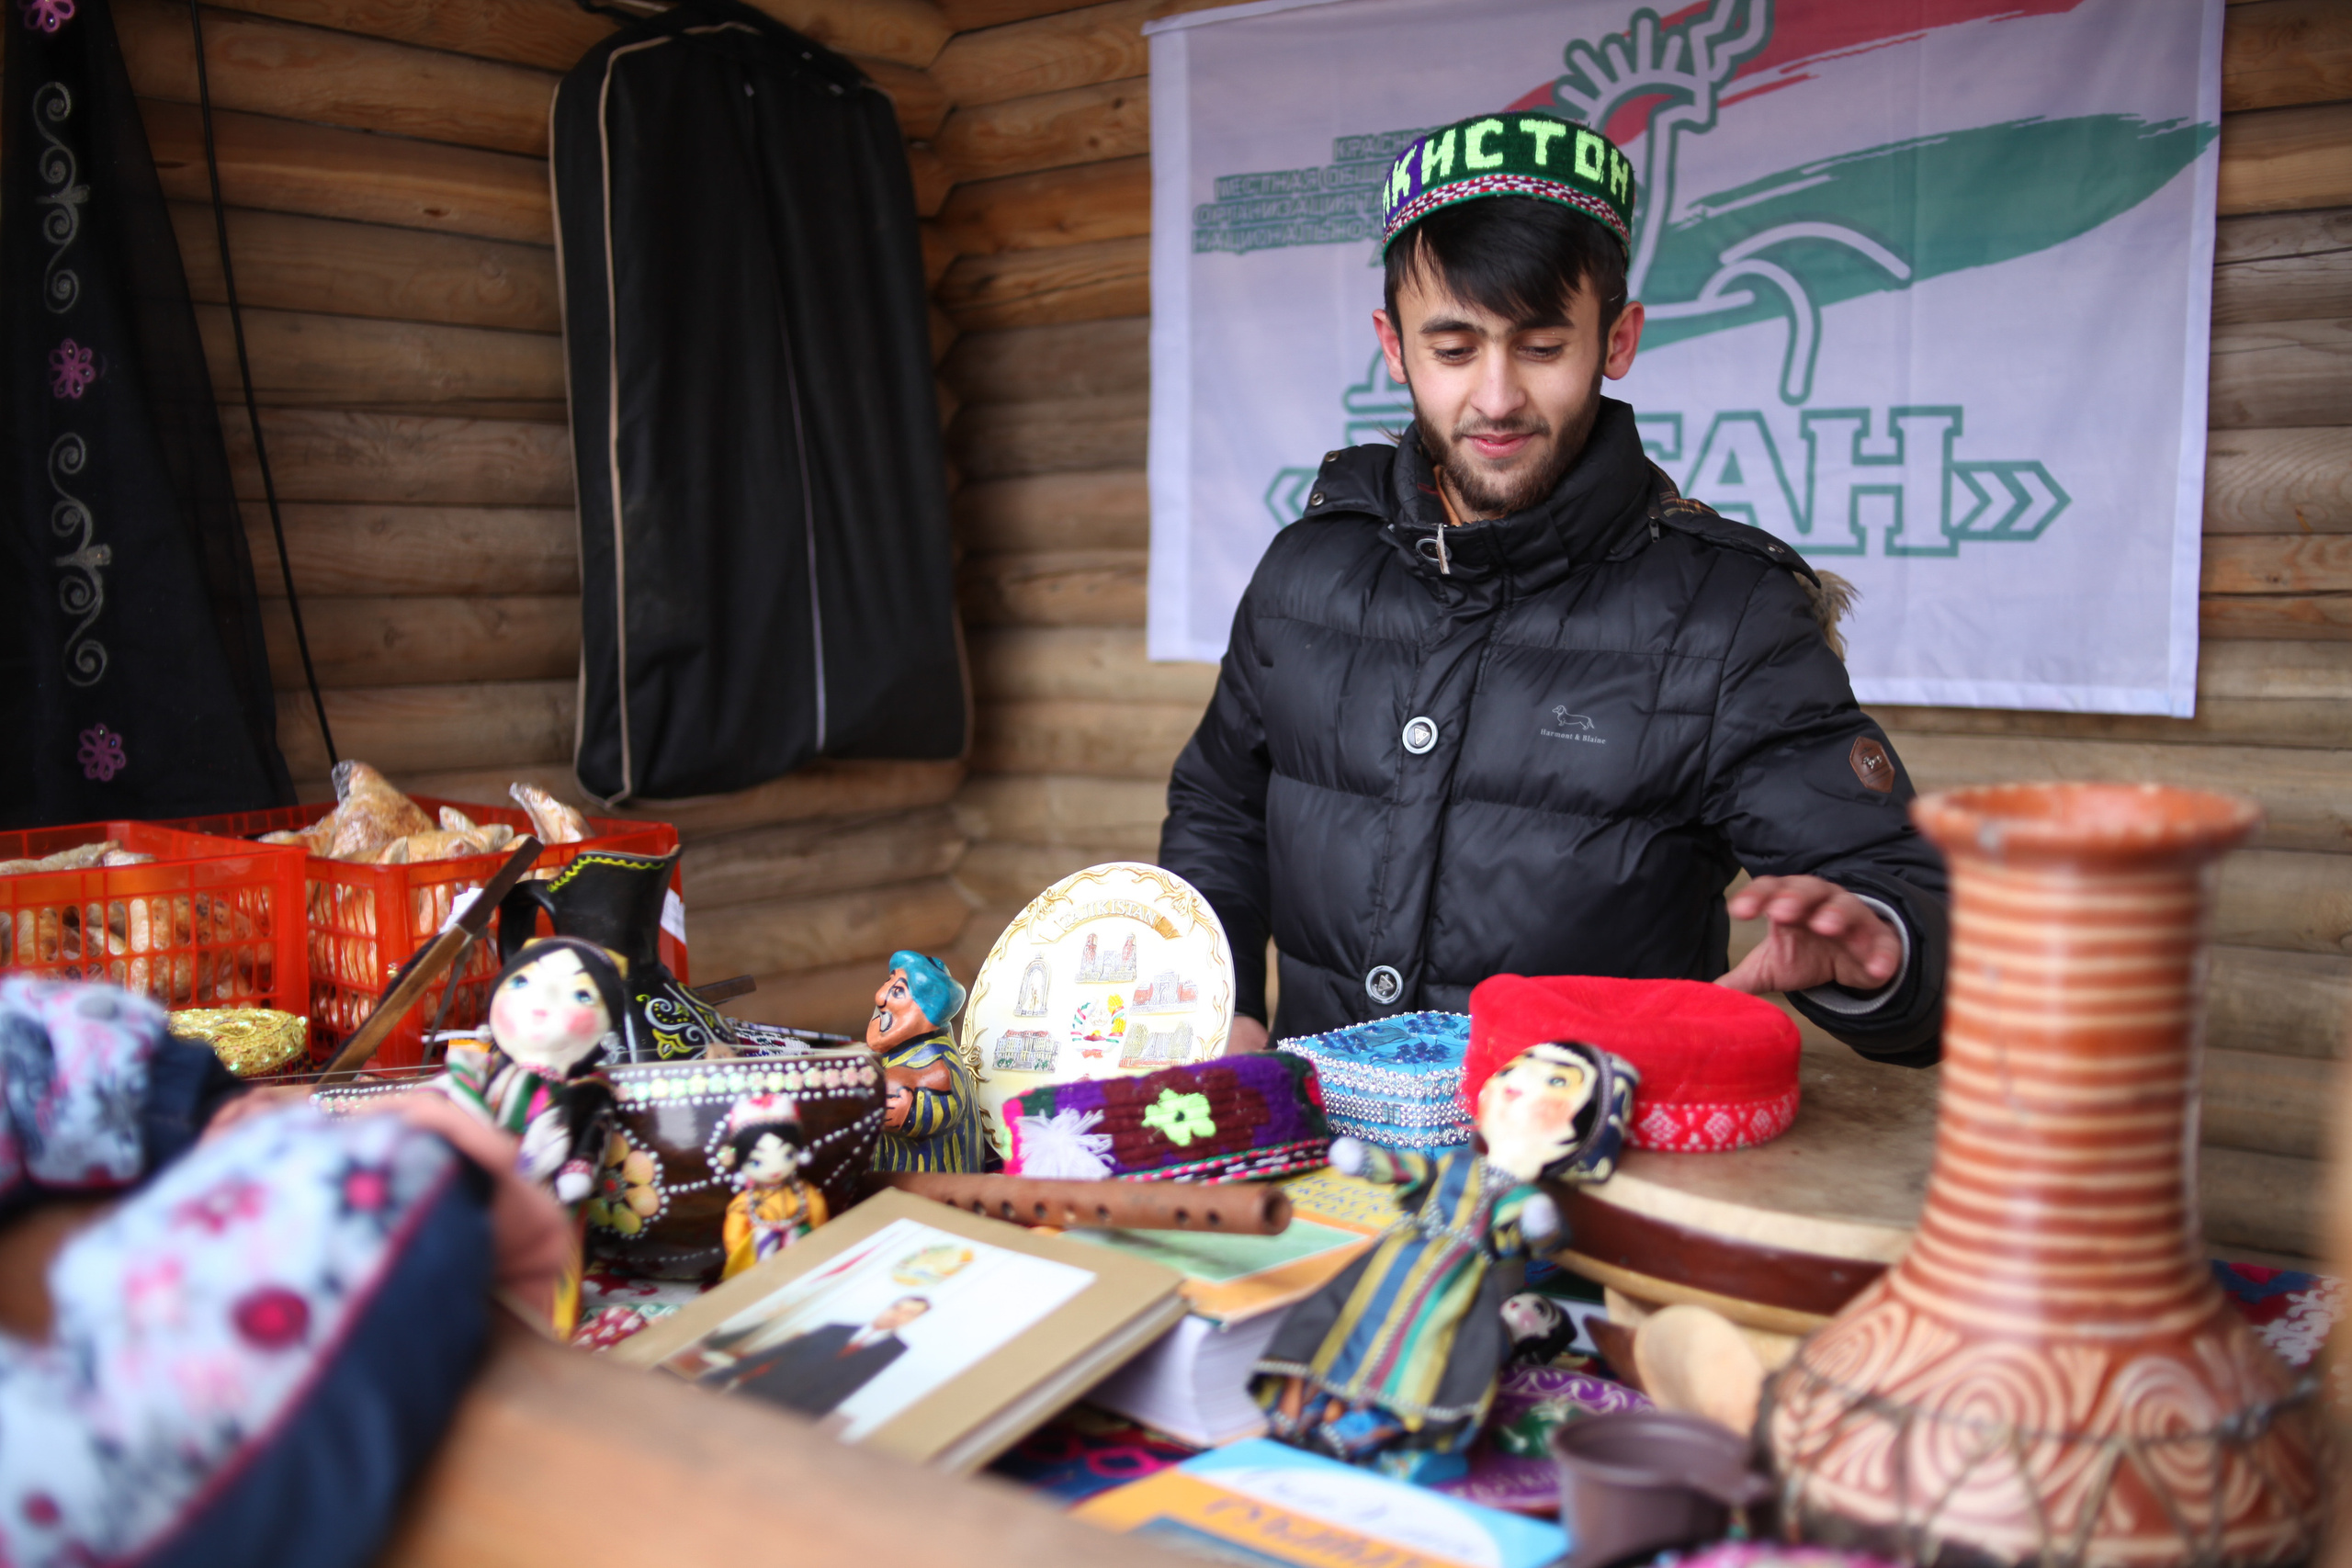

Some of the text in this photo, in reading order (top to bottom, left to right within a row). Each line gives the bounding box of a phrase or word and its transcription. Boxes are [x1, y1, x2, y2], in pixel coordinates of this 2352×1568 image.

[1215, 167, 1319, 201] МЕСТНАЯ
[1540, 728, 1606, 745] Harmont & Blaine
[1060, 899, 1158, 929] TAJIKISTAN
